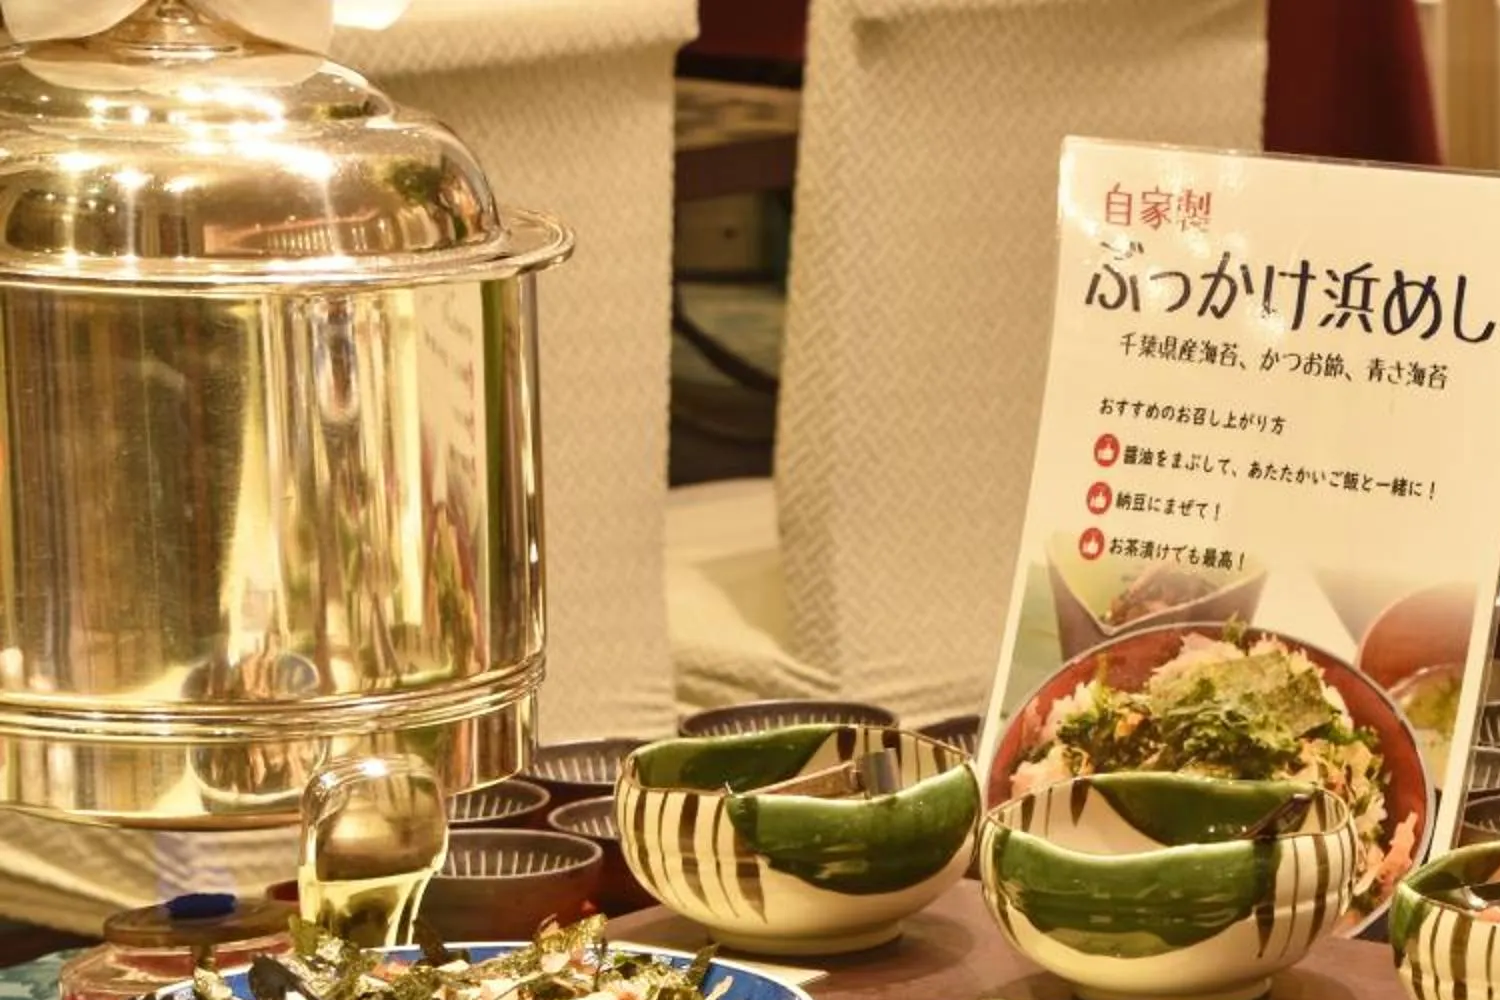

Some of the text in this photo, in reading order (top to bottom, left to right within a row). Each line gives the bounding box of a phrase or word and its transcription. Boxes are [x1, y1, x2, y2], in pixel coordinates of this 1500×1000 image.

[1105, 183, 1212, 232] 自家製
[1085, 241, 1496, 343] ぶっかけ浜めし
[1120, 332, 1448, 390] 千葉県産海苔、かつお節、青さ海苔
[1100, 397, 1286, 435] おすすめのお召し上がり方
